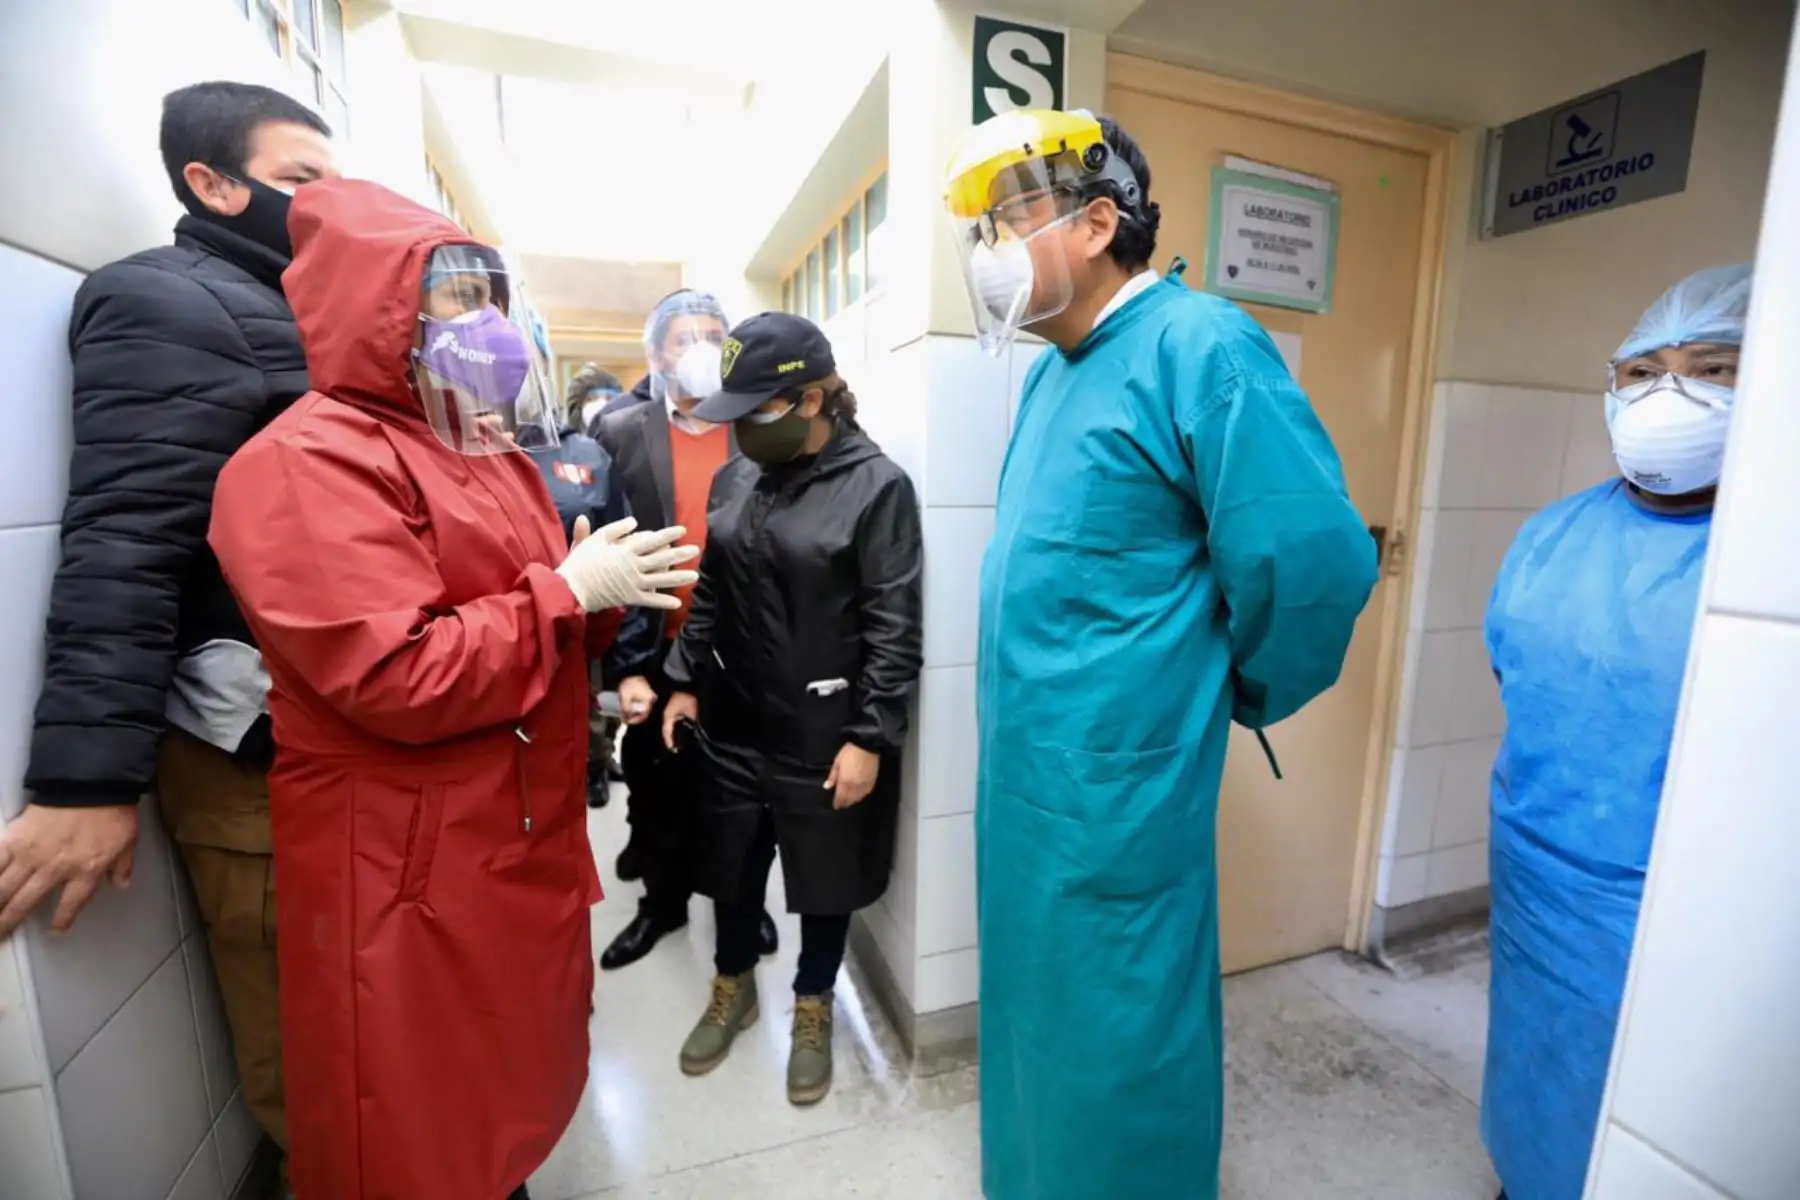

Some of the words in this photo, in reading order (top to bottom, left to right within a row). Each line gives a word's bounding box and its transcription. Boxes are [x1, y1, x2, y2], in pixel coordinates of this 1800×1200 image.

[983, 30, 1054, 116] S
[1509, 152, 1655, 208] LABORATORIO
[1244, 204, 1311, 226] LABORATORIO
[1533, 186, 1617, 221] CLINICO
